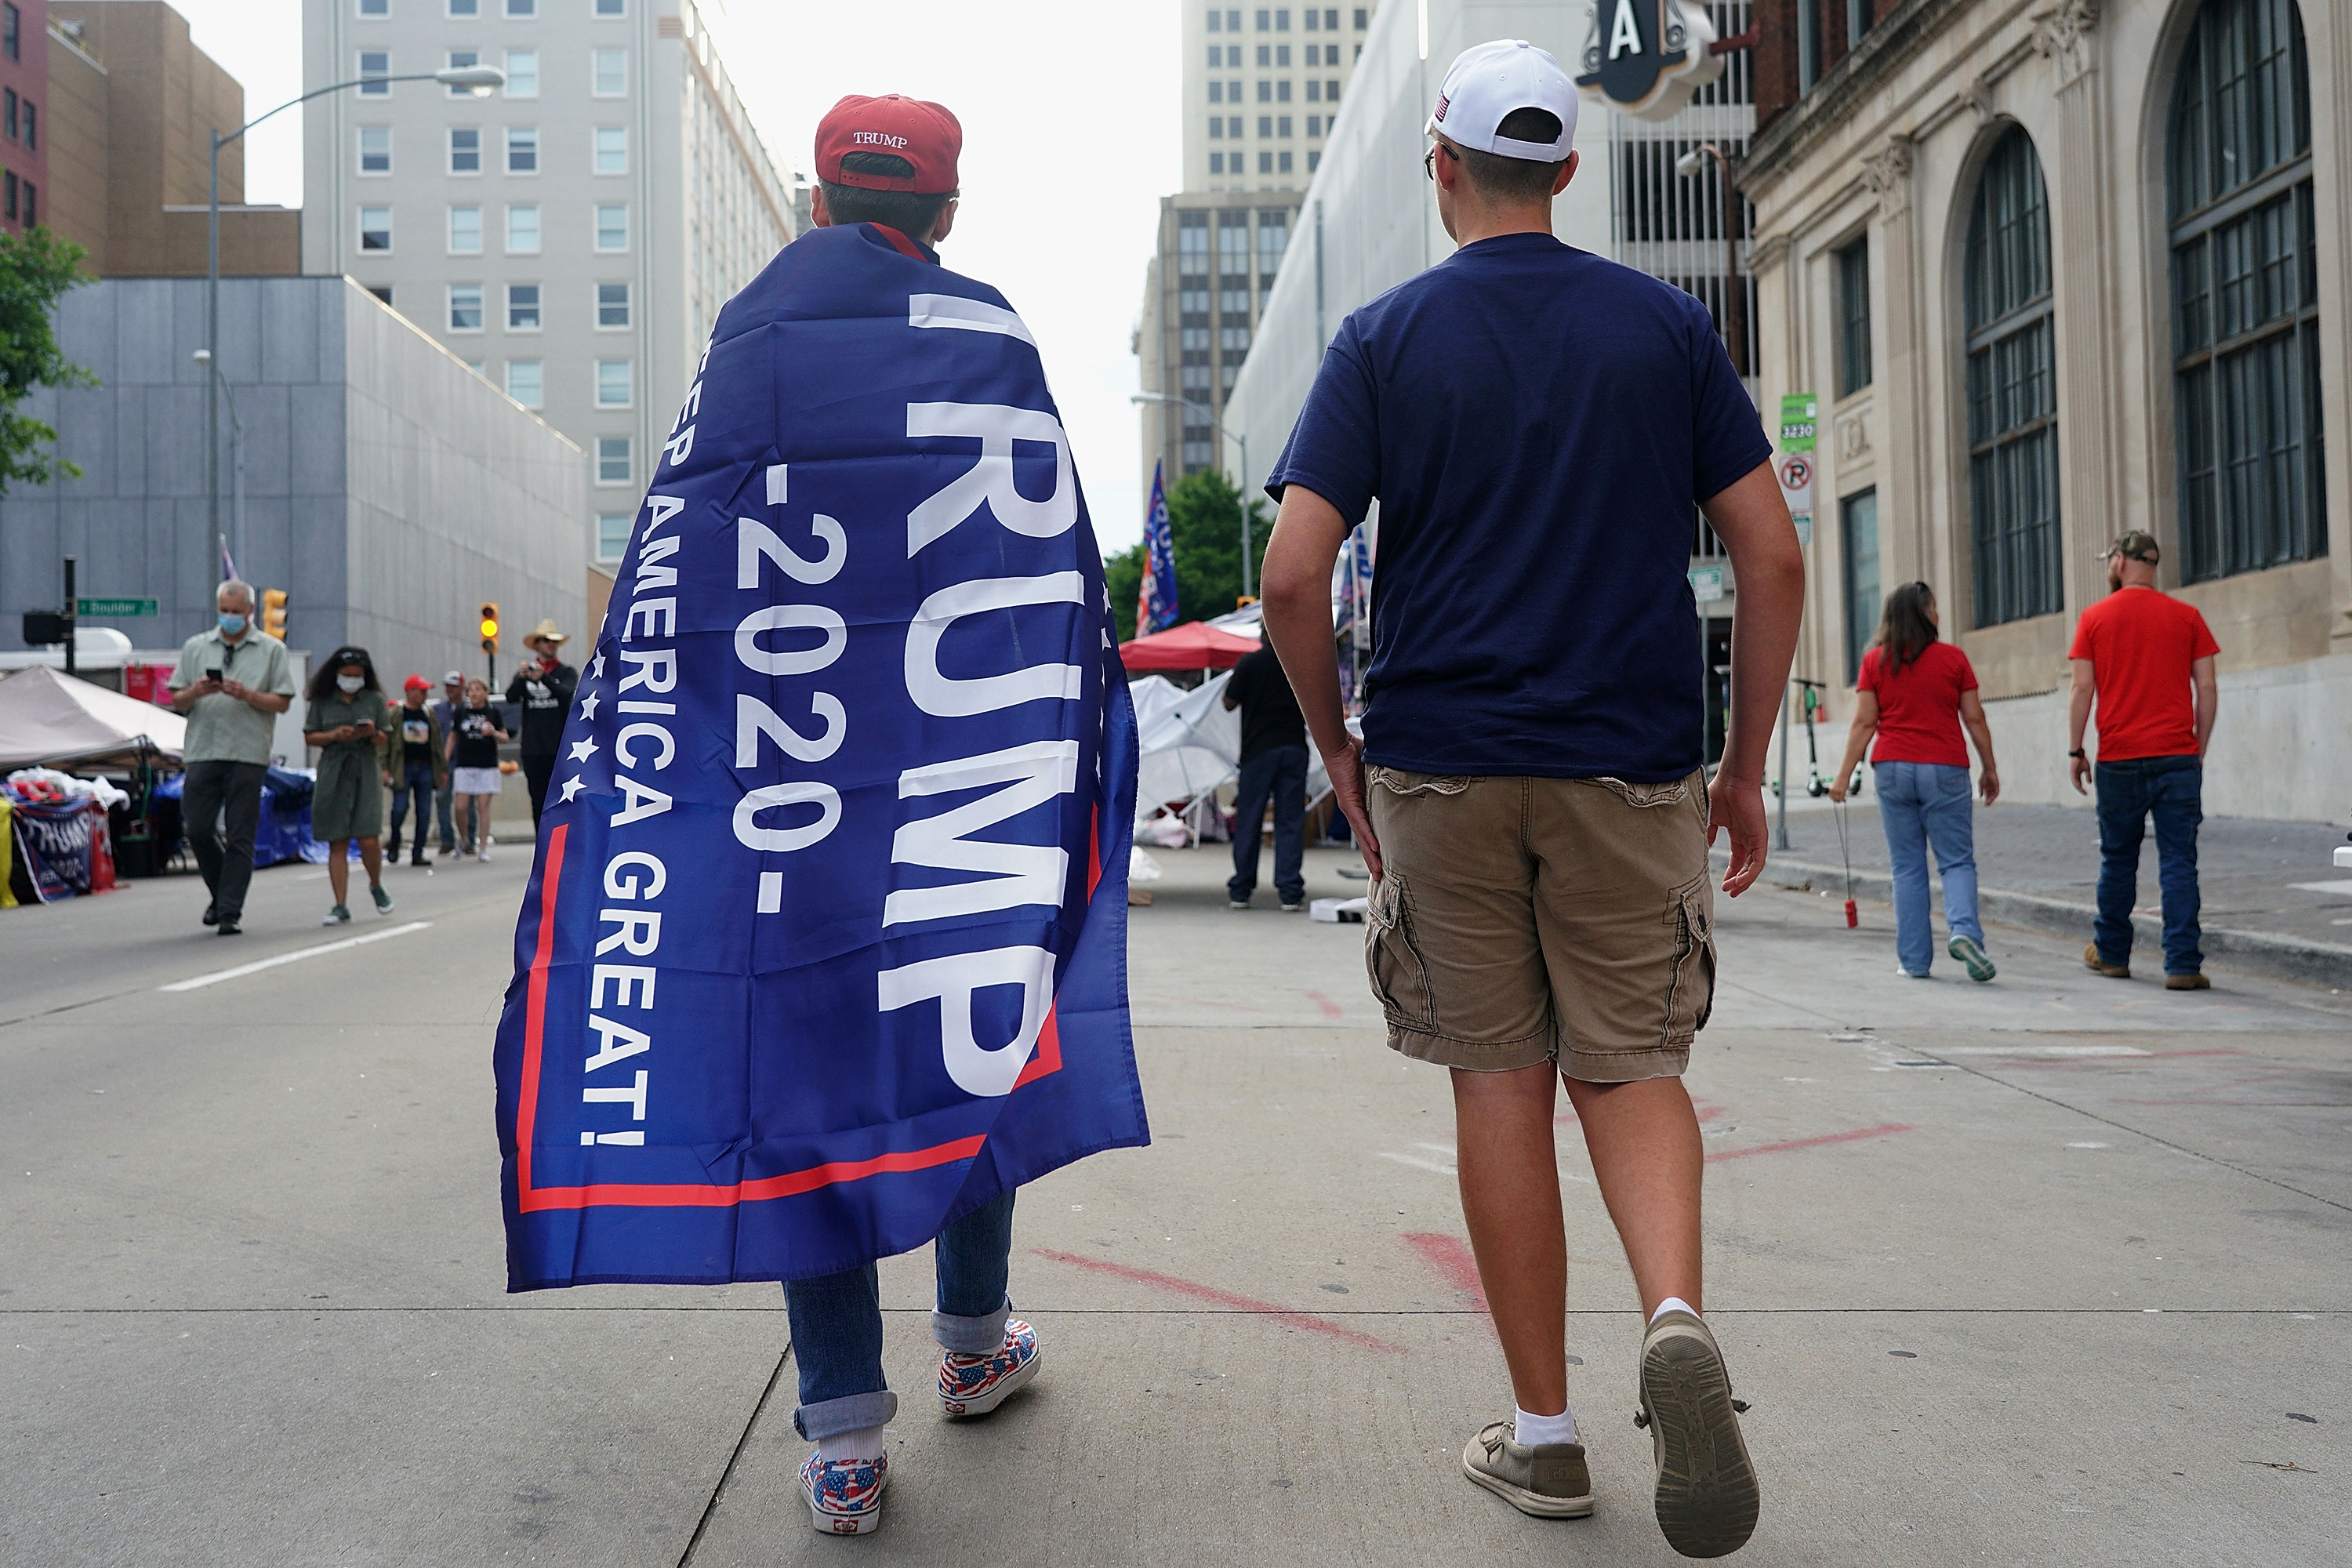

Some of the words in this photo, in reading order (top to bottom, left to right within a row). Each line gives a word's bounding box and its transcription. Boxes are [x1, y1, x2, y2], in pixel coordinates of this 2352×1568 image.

[1608, 0, 1642, 60] A
[853, 132, 908, 149] TRUMP
[1781, 423, 1813, 439] 3230
[91, 602, 136, 612] Boulder
[609, 495, 685, 829] AMERICA
[878, 293, 1084, 1097] TRUMP
[23, 811, 91, 853] TRUMP
[580, 851, 666, 1147] GREAT!
